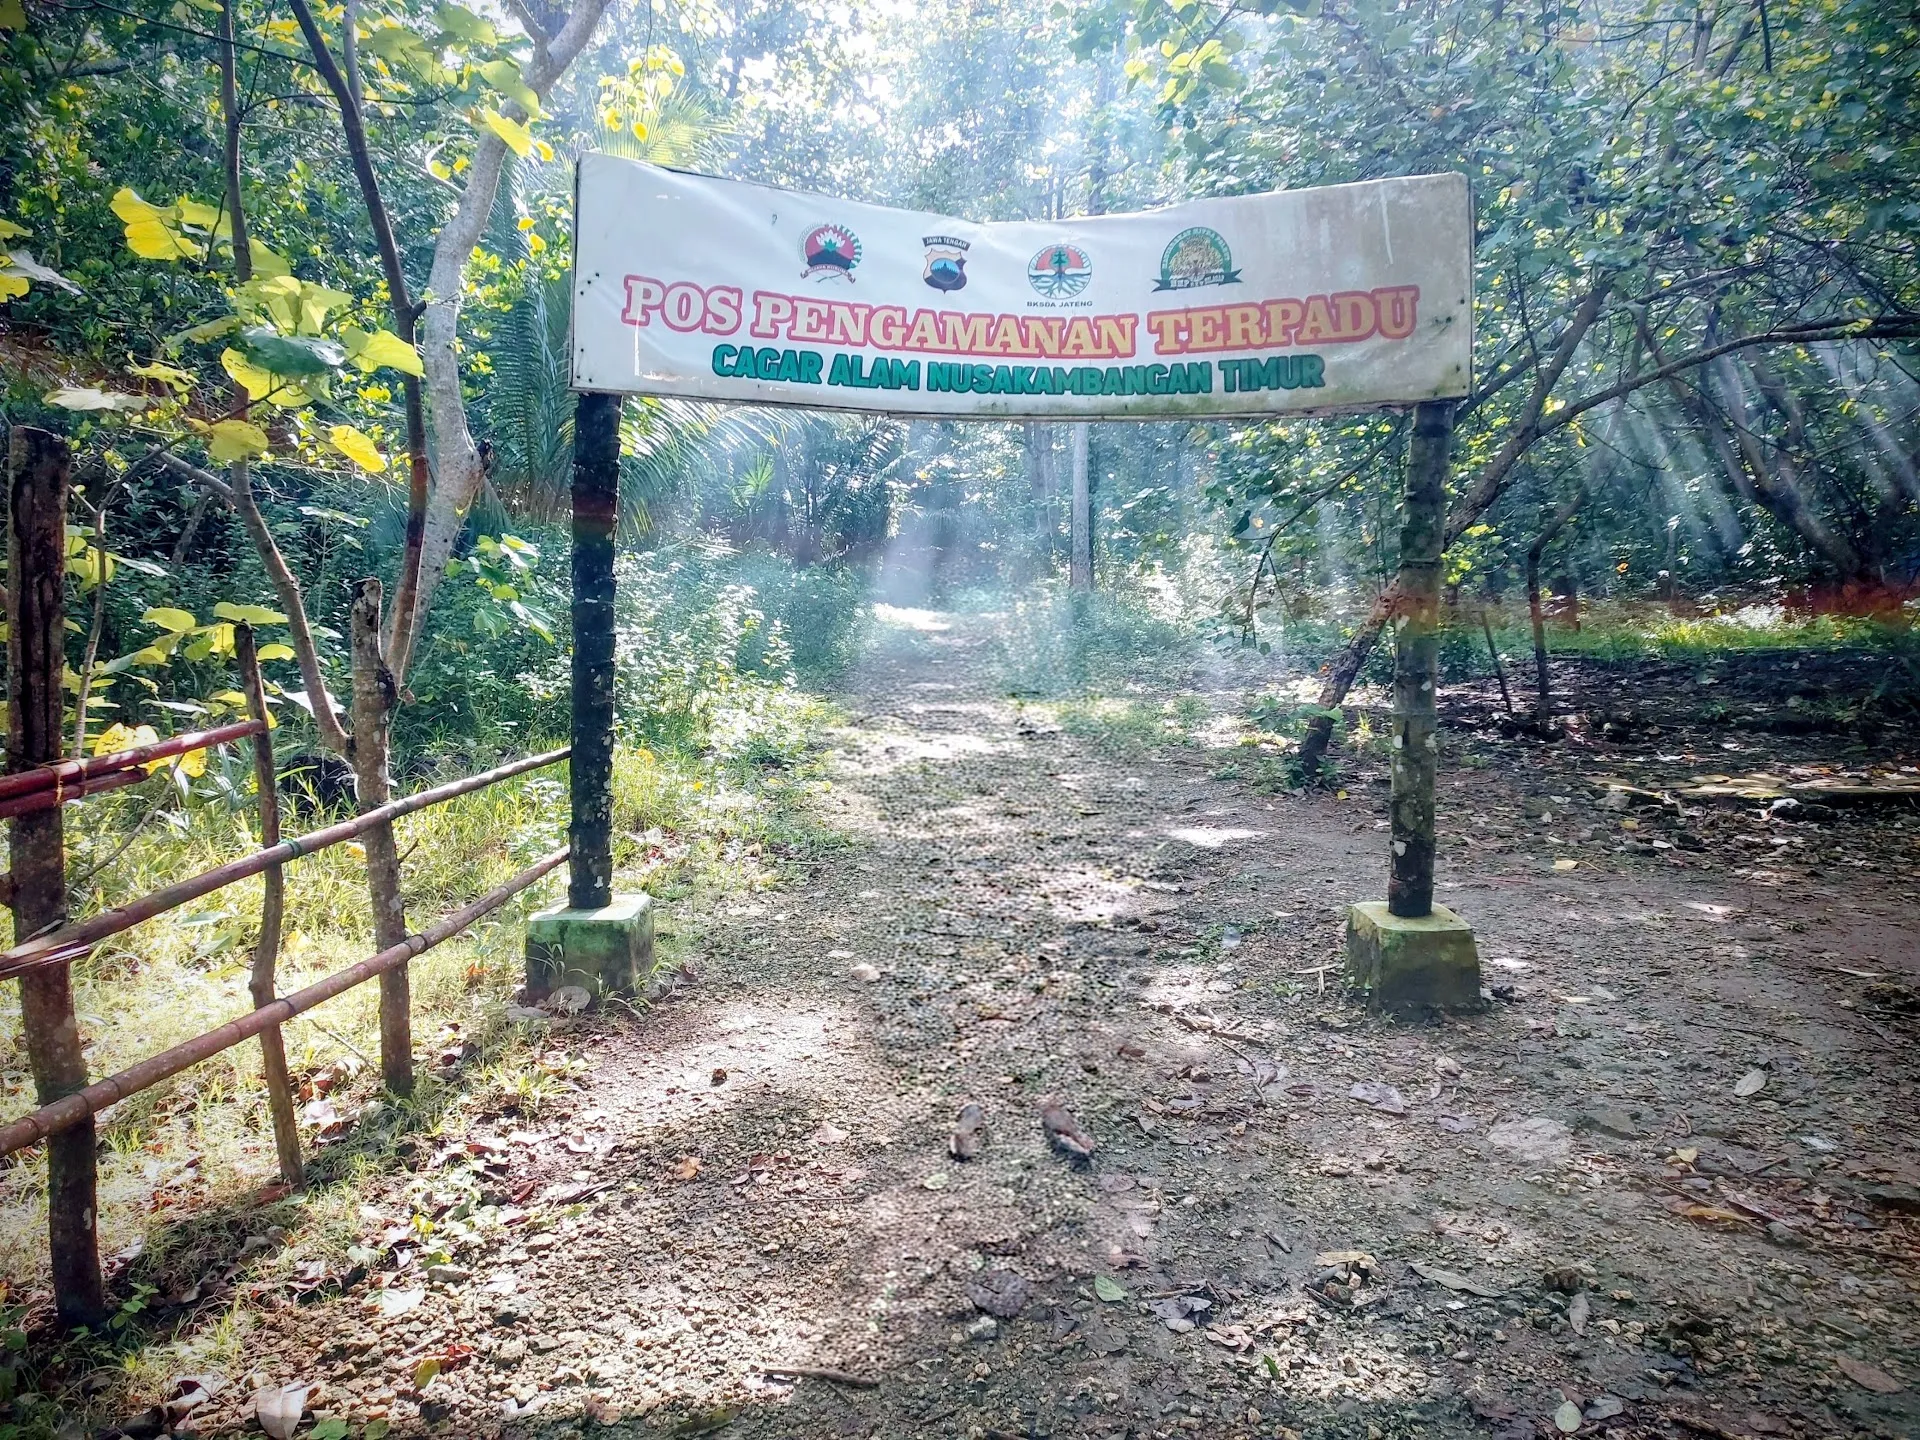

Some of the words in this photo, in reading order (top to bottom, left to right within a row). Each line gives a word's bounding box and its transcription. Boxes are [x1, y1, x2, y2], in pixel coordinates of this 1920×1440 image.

[926, 237, 942, 245] JAWA
[943, 237, 967, 249] TENGAH
[621, 274, 743, 336] POS
[750, 290, 1139, 359] PENGAMANAN
[1147, 285, 1420, 355] TERPADU
[1058, 300, 1093, 308] JATENG
[712, 343, 823, 384] CAGAR
[827, 353, 920, 391] ALAM
[927, 361, 1212, 396] NUSAKAMBANGAN
[1218, 354, 1326, 393] TIMUR
